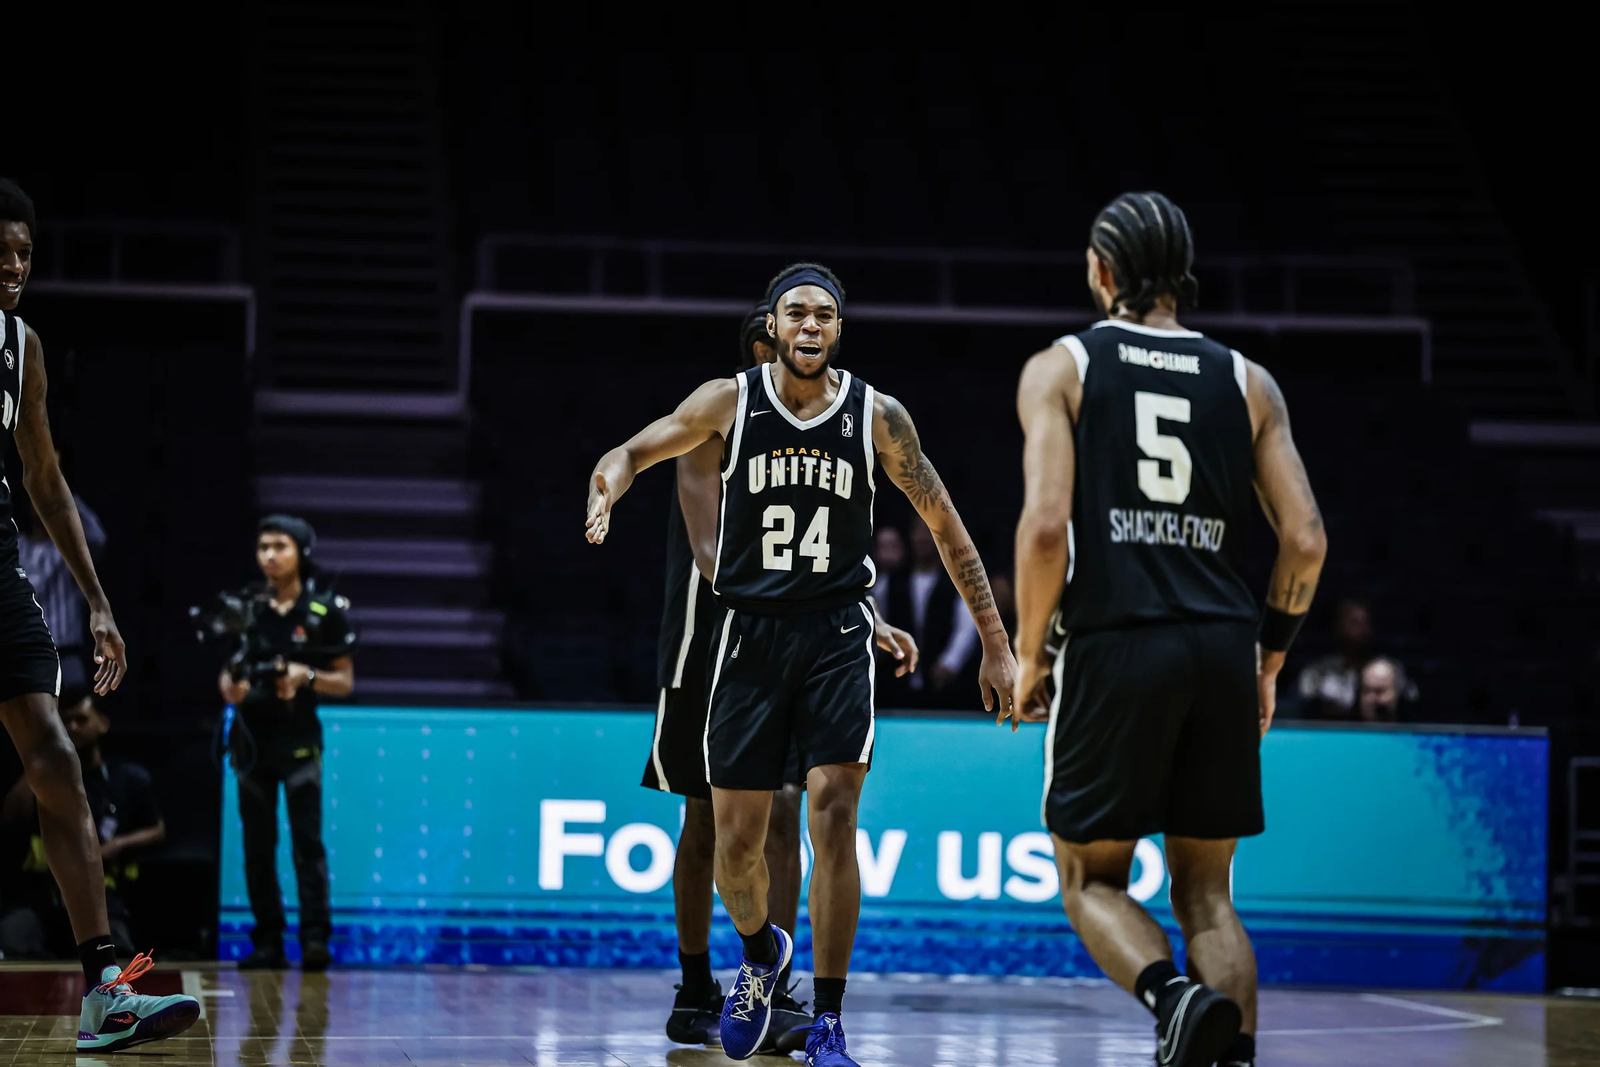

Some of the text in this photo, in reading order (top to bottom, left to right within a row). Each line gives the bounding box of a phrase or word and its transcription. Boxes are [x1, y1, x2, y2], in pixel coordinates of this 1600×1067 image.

[748, 453, 854, 500] UNITED
[772, 447, 832, 461] NBAGL
[1134, 391, 1193, 505] 5
[761, 504, 831, 573] 24
[538, 799, 908, 898] Fow
[936, 830, 1060, 903] us
